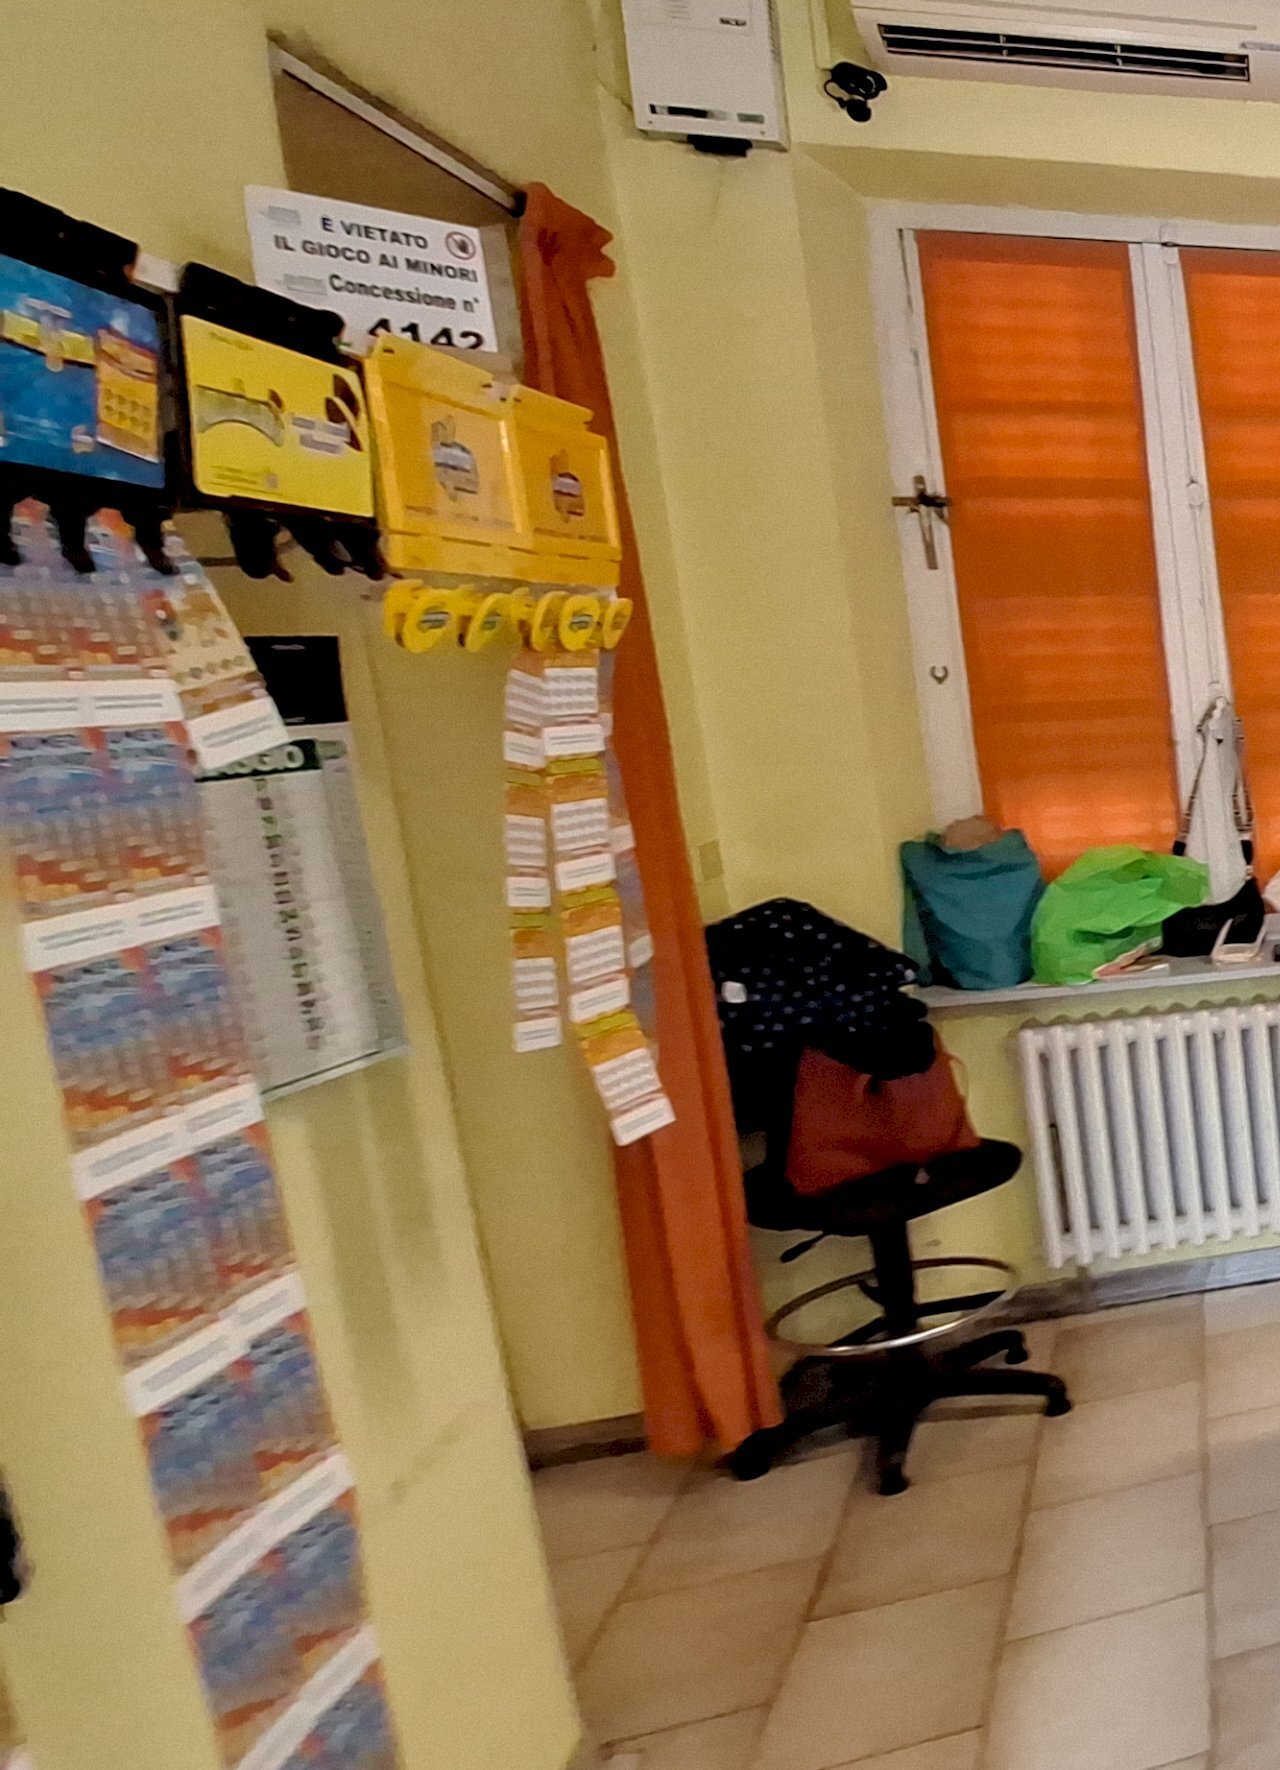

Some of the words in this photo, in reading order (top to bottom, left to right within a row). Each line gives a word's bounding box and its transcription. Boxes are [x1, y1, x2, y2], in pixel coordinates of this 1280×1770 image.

[340, 220, 428, 250] VIETATO
[274, 235, 296, 251] IL
[302, 240, 370, 264] GIOCO
[379, 255, 398, 270] AI
[405, 257, 479, 283] MINORI
[328, 274, 457, 310] Concessione
